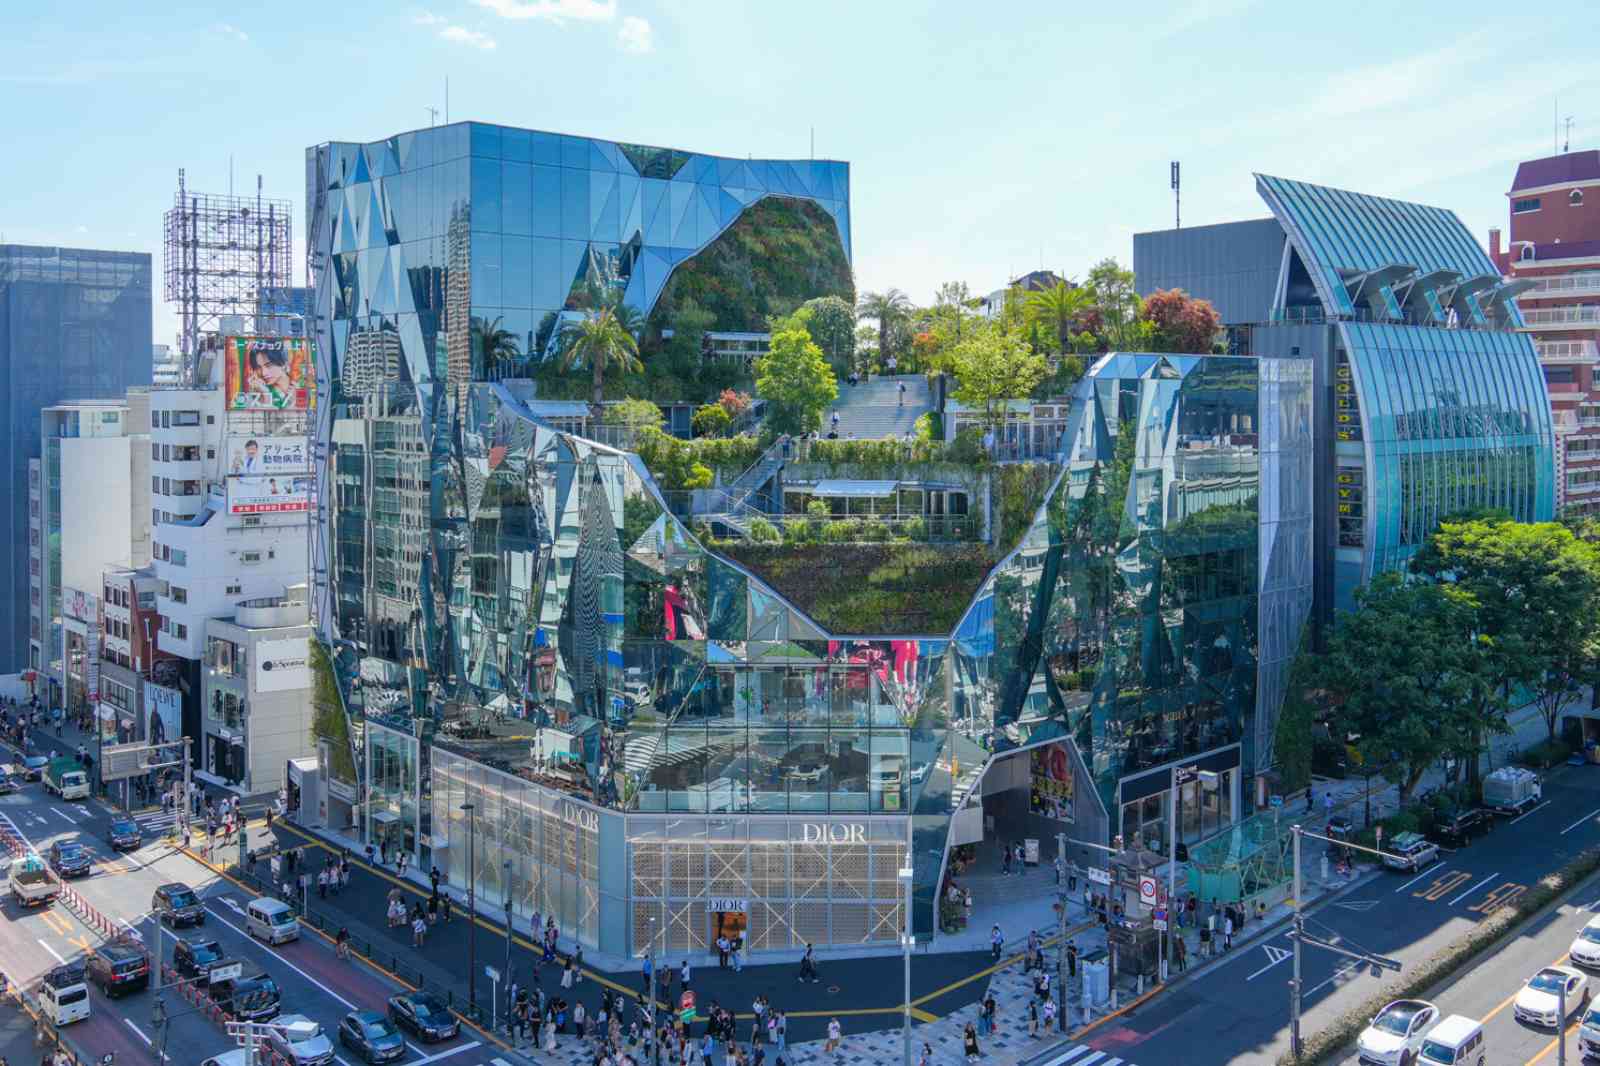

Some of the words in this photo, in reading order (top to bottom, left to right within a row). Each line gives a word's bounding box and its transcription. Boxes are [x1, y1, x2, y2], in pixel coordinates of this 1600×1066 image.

[1337, 474, 1352, 513] GYM
[564, 801, 599, 832] DIOR
[803, 823, 866, 843] DIOR
[708, 898, 746, 911] DIOR
